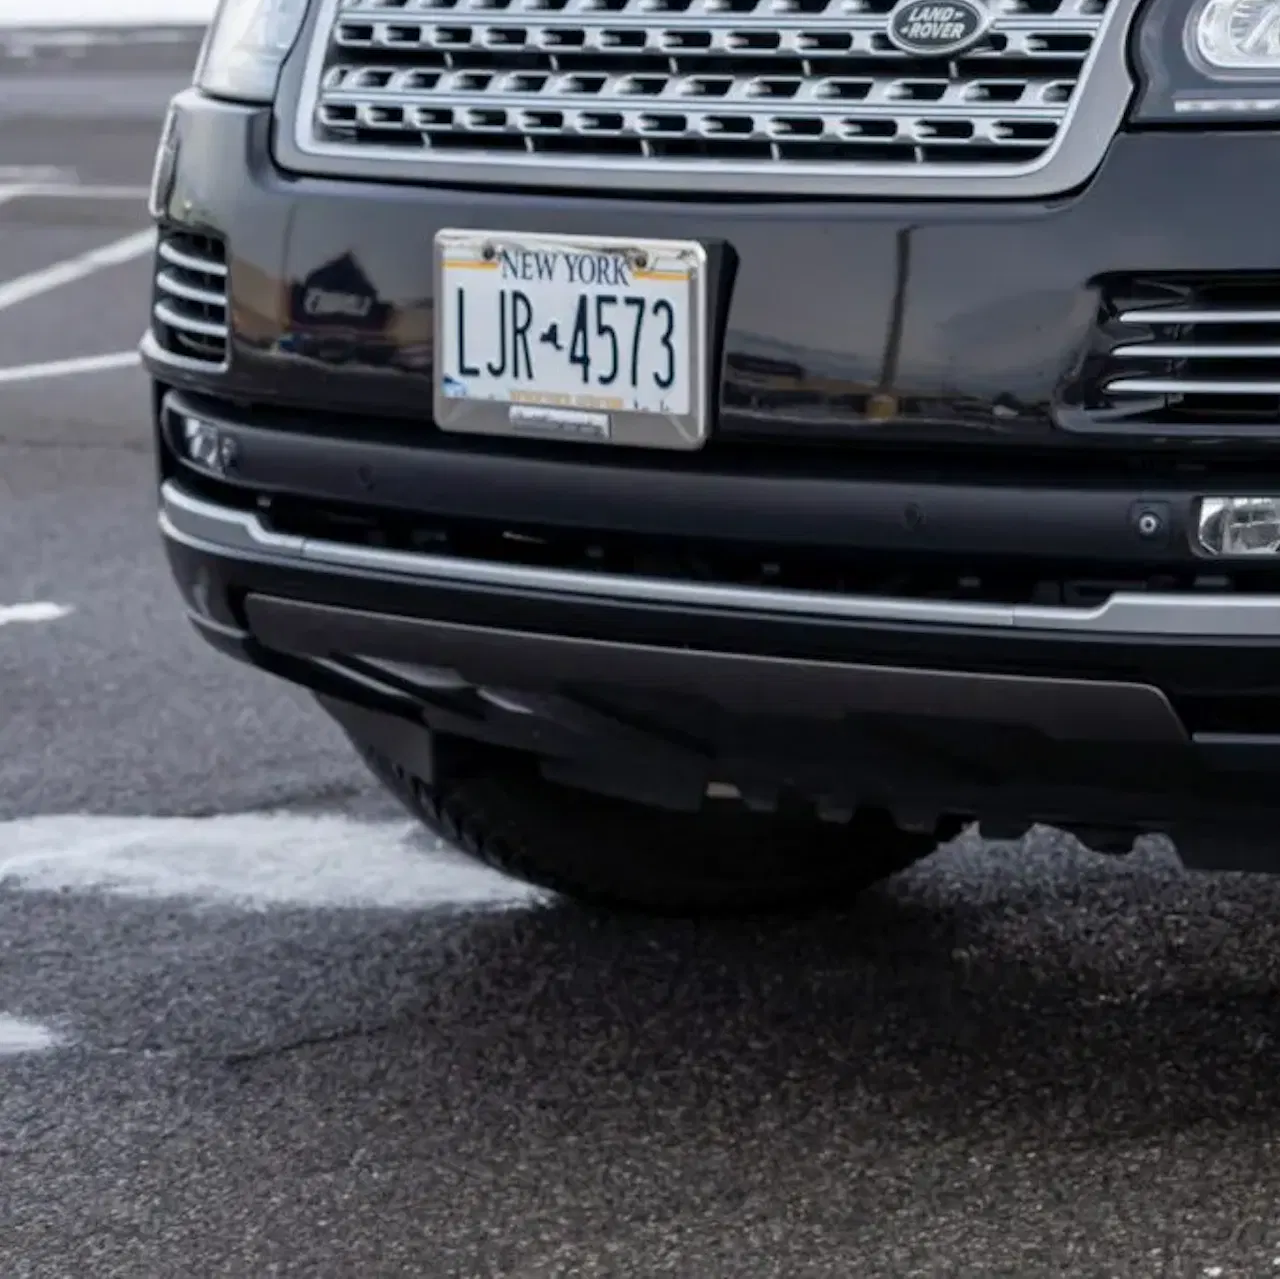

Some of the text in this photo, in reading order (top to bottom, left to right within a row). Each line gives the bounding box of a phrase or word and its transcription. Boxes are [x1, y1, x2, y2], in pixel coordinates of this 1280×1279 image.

[908, 23, 965, 38] ROVER
[502, 250, 629, 287] NEW YORK
